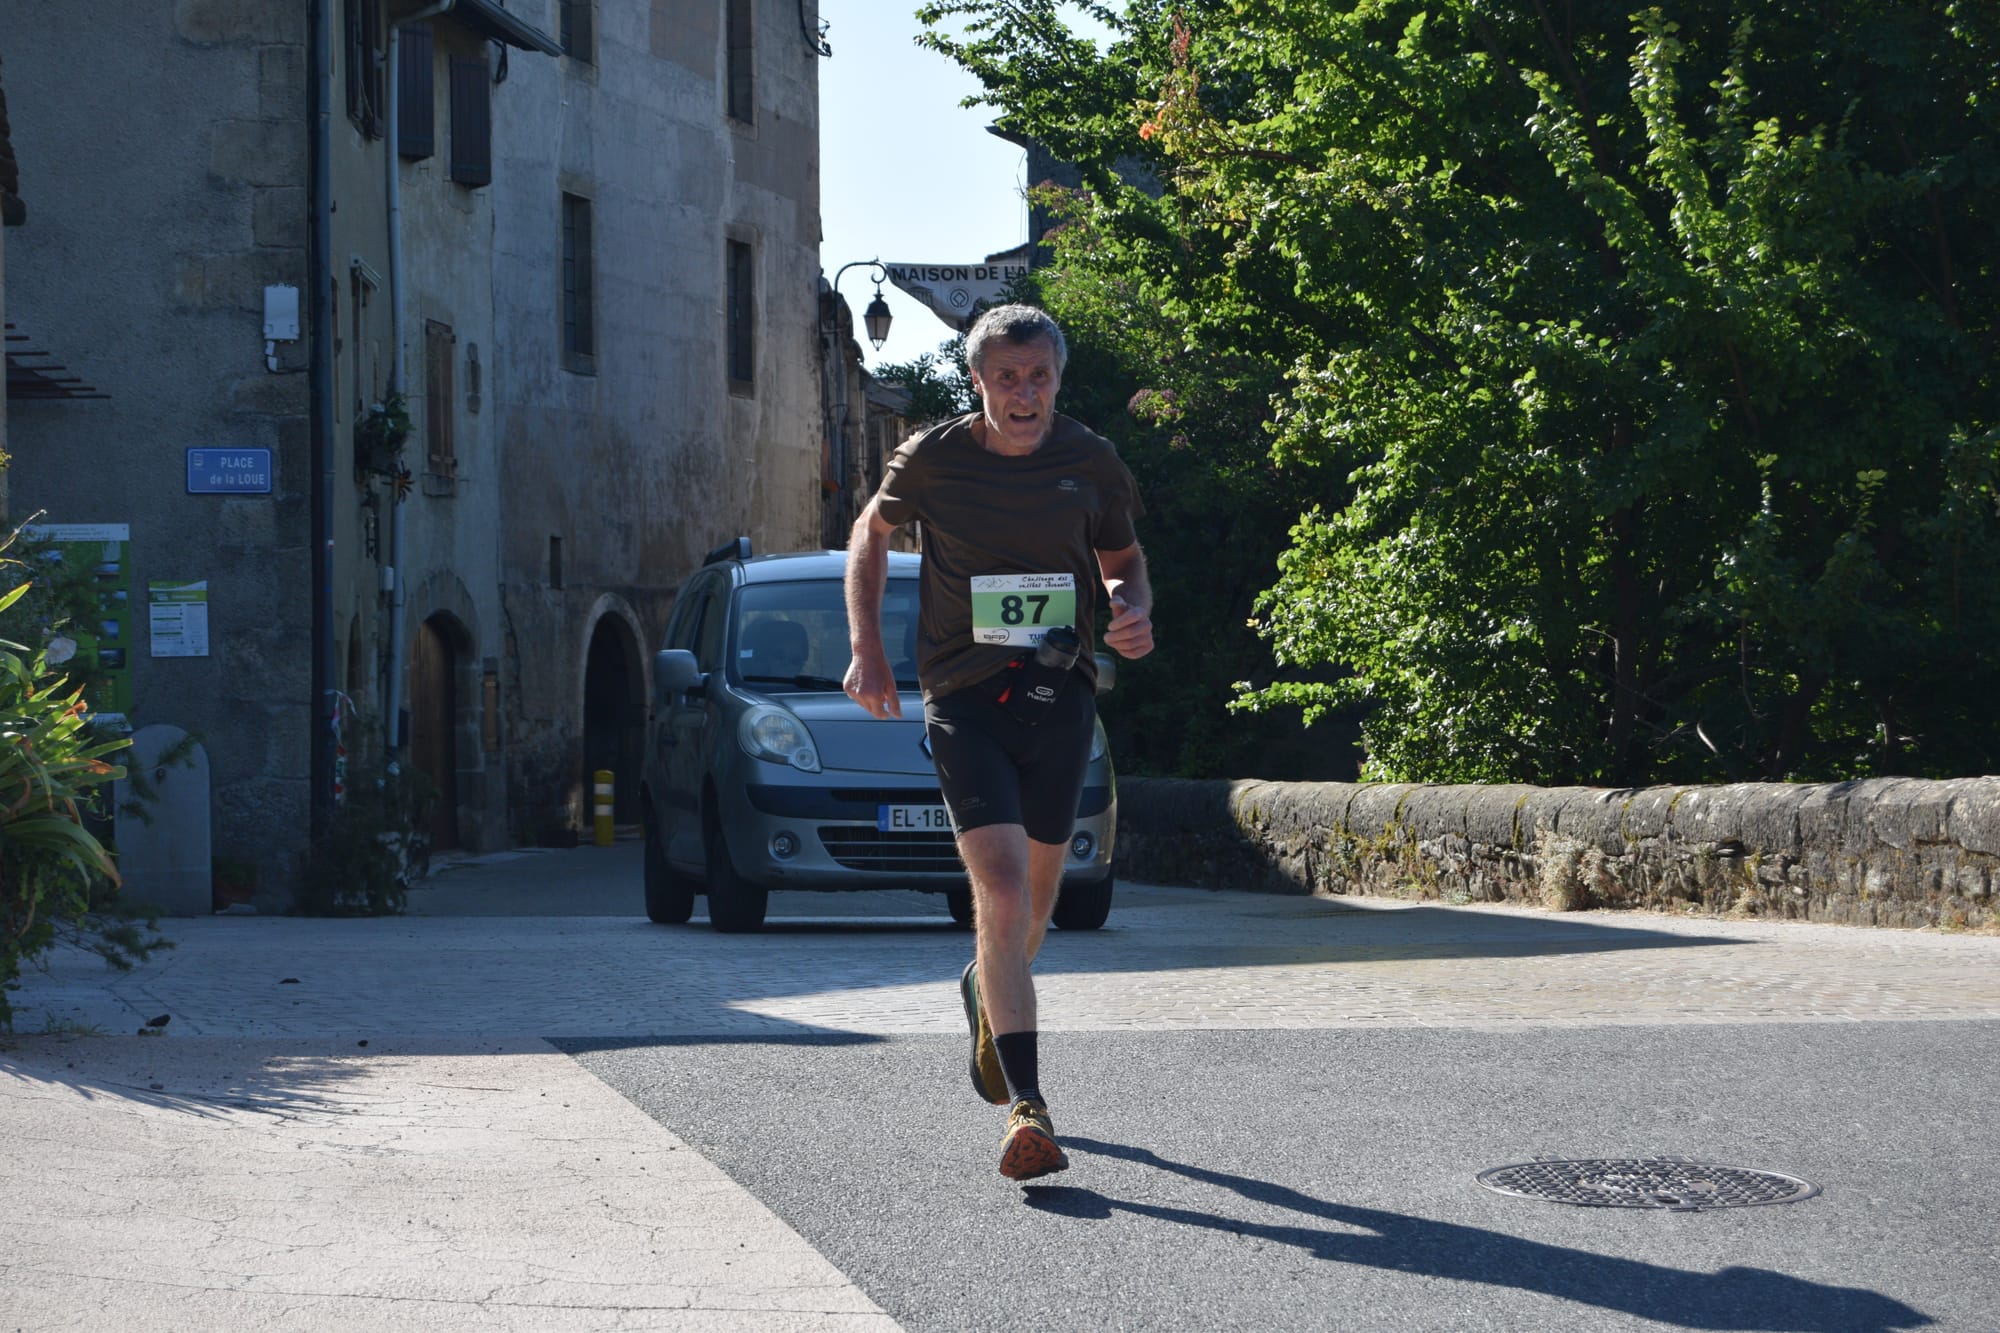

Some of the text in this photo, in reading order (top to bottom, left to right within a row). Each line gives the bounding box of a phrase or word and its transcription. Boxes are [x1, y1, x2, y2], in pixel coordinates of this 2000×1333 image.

[892, 267, 968, 282] MAISON
[975, 267, 999, 280] DE
[220, 456, 254, 468] PLACE
[209, 474, 265, 485] de la LOUE
[1022, 576, 1054, 584] Challenge
[1001, 595, 1050, 625] 87
